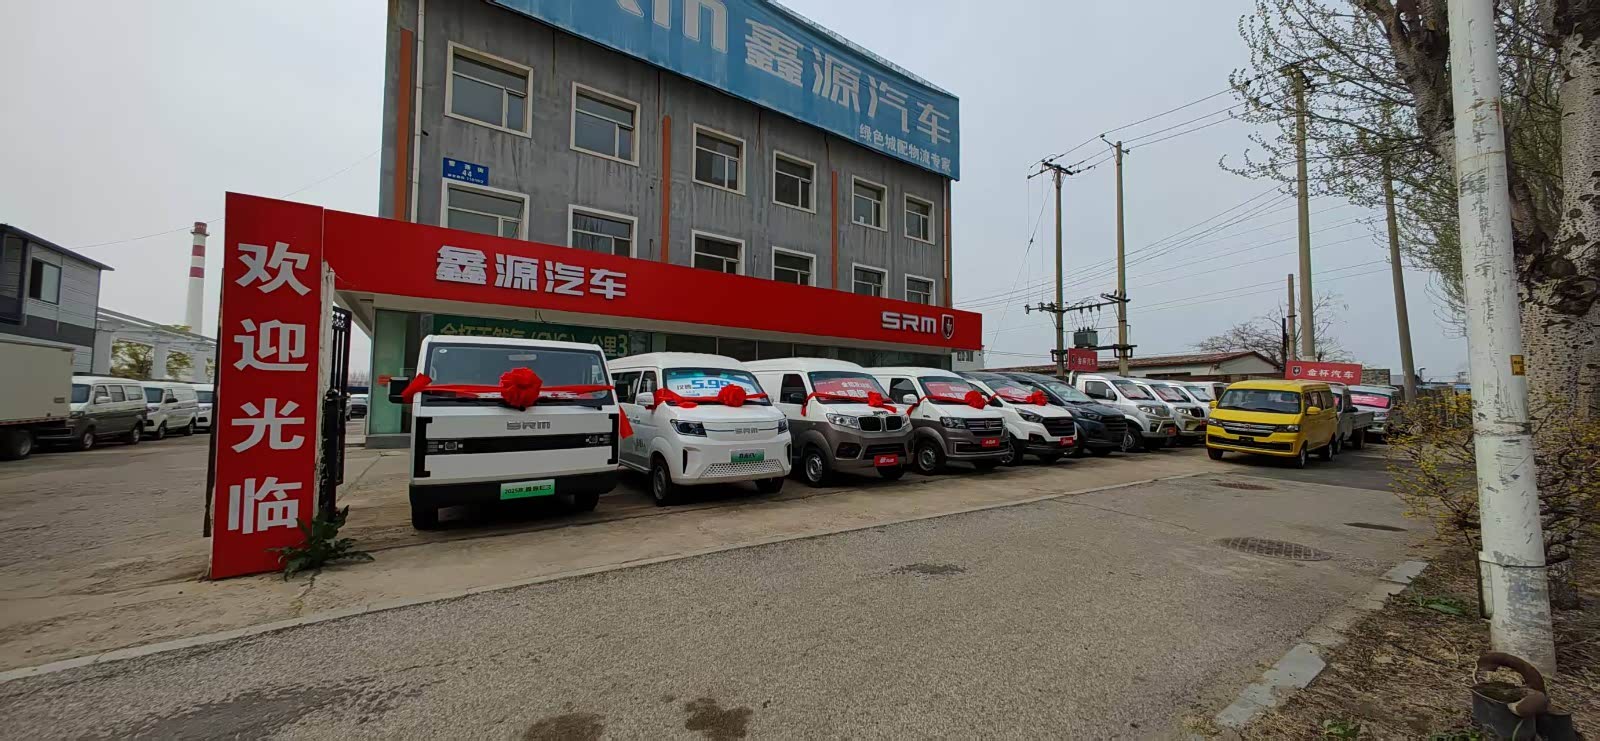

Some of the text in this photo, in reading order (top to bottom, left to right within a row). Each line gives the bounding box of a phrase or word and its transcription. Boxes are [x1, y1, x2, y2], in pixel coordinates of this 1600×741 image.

[745, 17, 951, 145] 鑫源汽车
[859, 123, 951, 172] 绿色城配物流专家
[436, 244, 627, 299] 鑫源汽车
[882, 311, 937, 333] SRM
[227, 241, 311, 534] 欢迎光临
[1307, 368, 1355, 379] 金杯汽车
[507, 421, 550, 430] SRM
